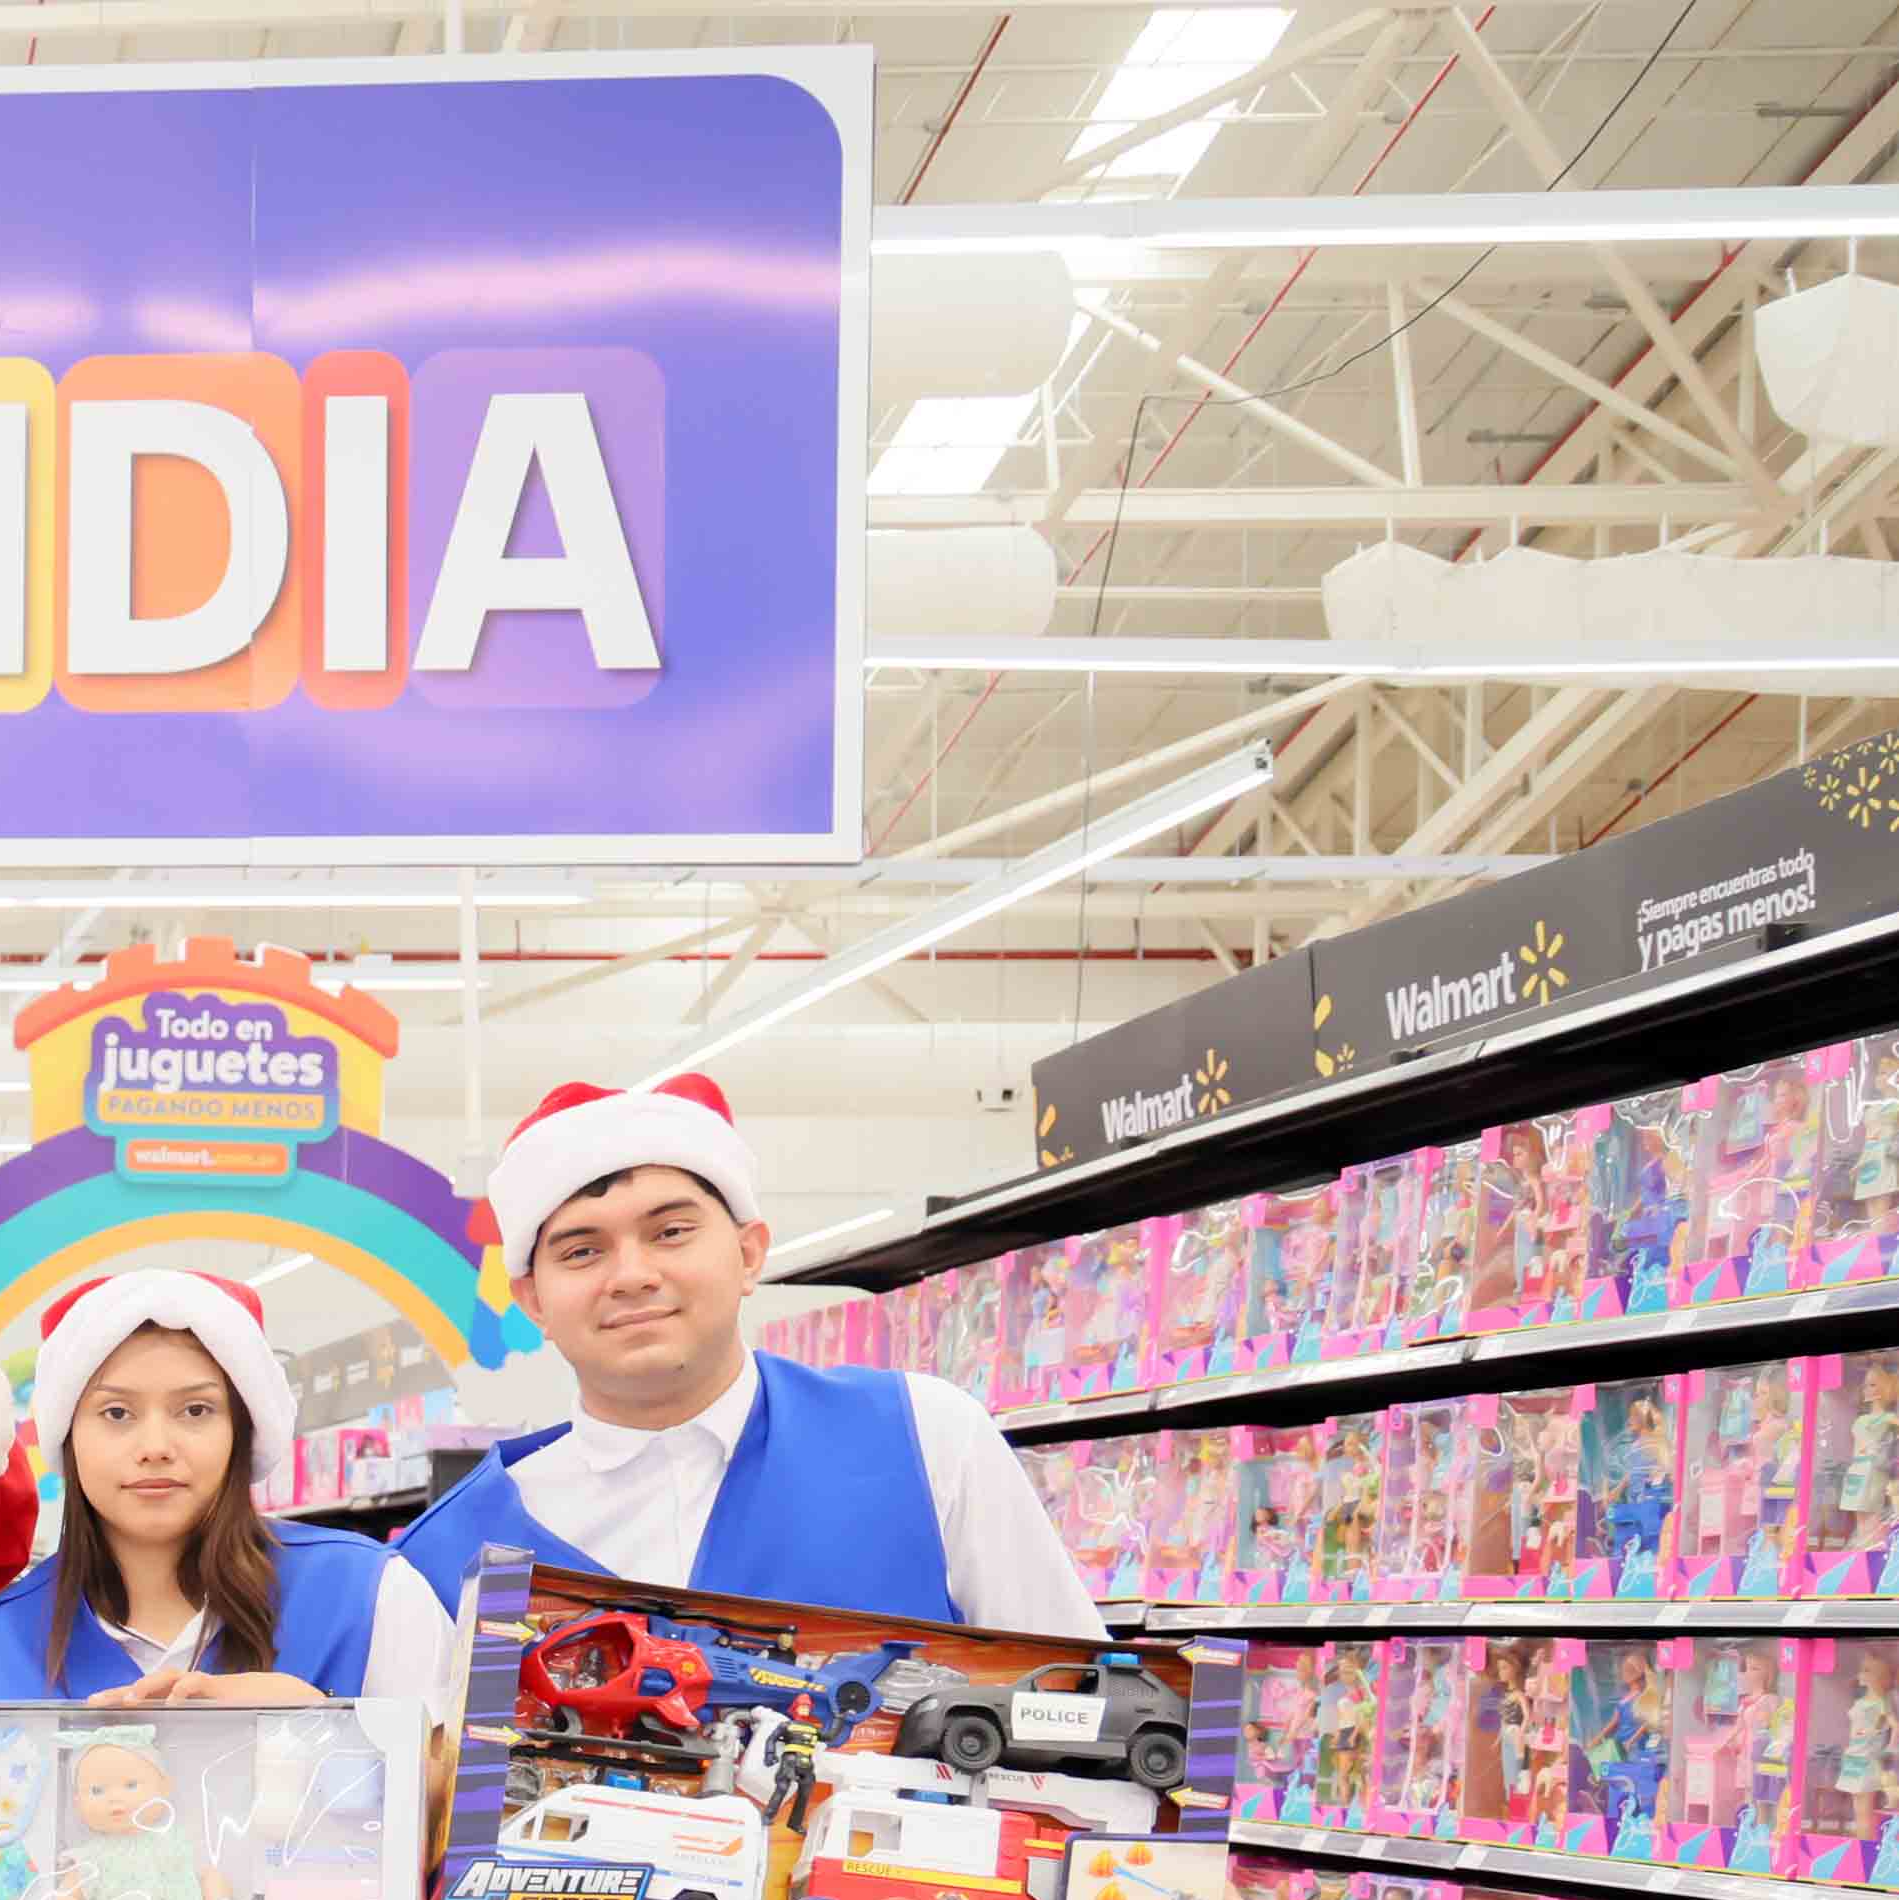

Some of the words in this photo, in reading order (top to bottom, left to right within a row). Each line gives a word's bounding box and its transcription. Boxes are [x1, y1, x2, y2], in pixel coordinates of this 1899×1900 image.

[1700, 863, 1777, 904] encuentras
[1778, 847, 1815, 878] todo
[1637, 933, 1654, 972] y
[1656, 911, 1724, 966] pagas
[1726, 869, 1816, 935] menos!
[1385, 951, 1517, 1040] Walmart
[155, 1009, 229, 1039] Todo
[235, 1019, 274, 1041] en
[98, 1032, 325, 1093] juguetes
[108, 1095, 224, 1118] PAGANDO
[232, 1100, 317, 1121] MENOS
[1102, 1072, 1195, 1143] Walmart
[1018, 1706, 1091, 1727] POLICE
[452, 1861, 645, 1900] ADVENTURE
